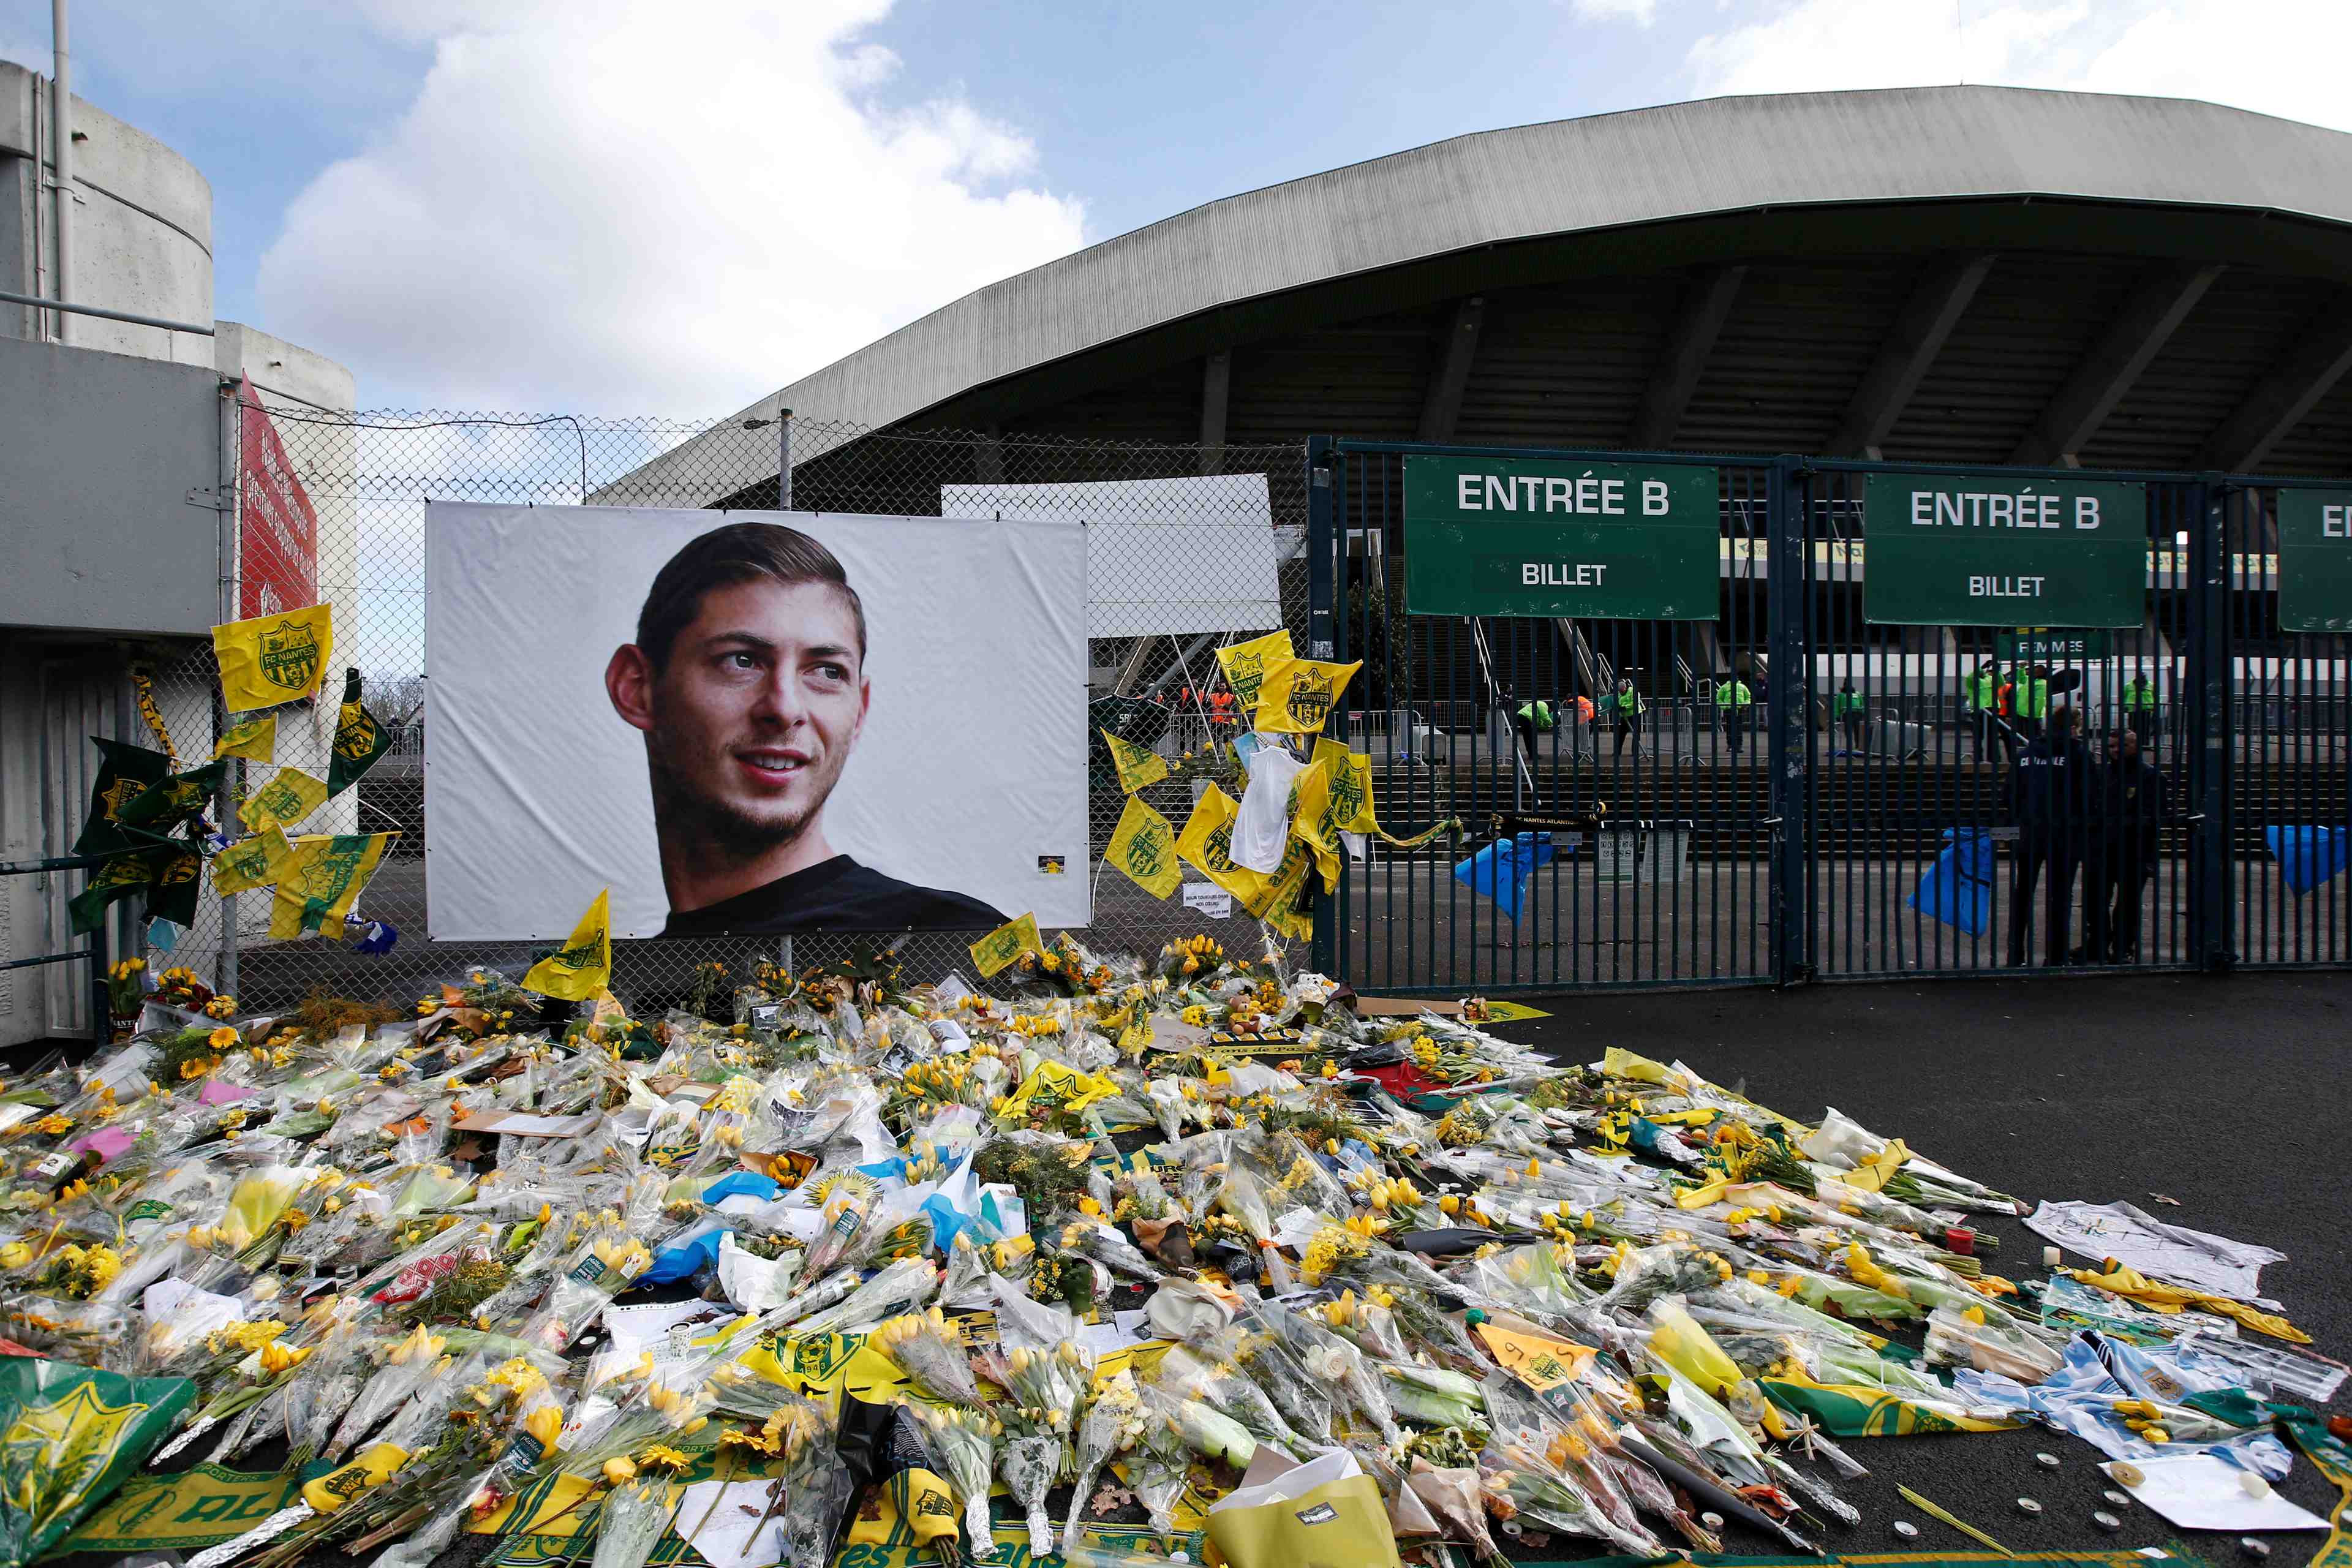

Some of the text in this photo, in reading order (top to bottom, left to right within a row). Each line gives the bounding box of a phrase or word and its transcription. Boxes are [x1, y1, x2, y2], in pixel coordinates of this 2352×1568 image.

[1458, 470, 1669, 516] ENTRÉE B
[1912, 487, 2101, 530] ENTRÉE B
[1522, 563, 1607, 586] BILLET
[1969, 576, 2045, 597] BILLET
[264, 646, 317, 666] FC NANTES
[1238, 674, 1263, 688] NANTE
[1292, 693, 1329, 703] FC NANTES
[1334, 780, 1343, 790] FC
[1136, 834, 1144, 846] FC
[799, 1362, 826, 1374] 1943
[201, 1463, 260, 1482] PORTERS
